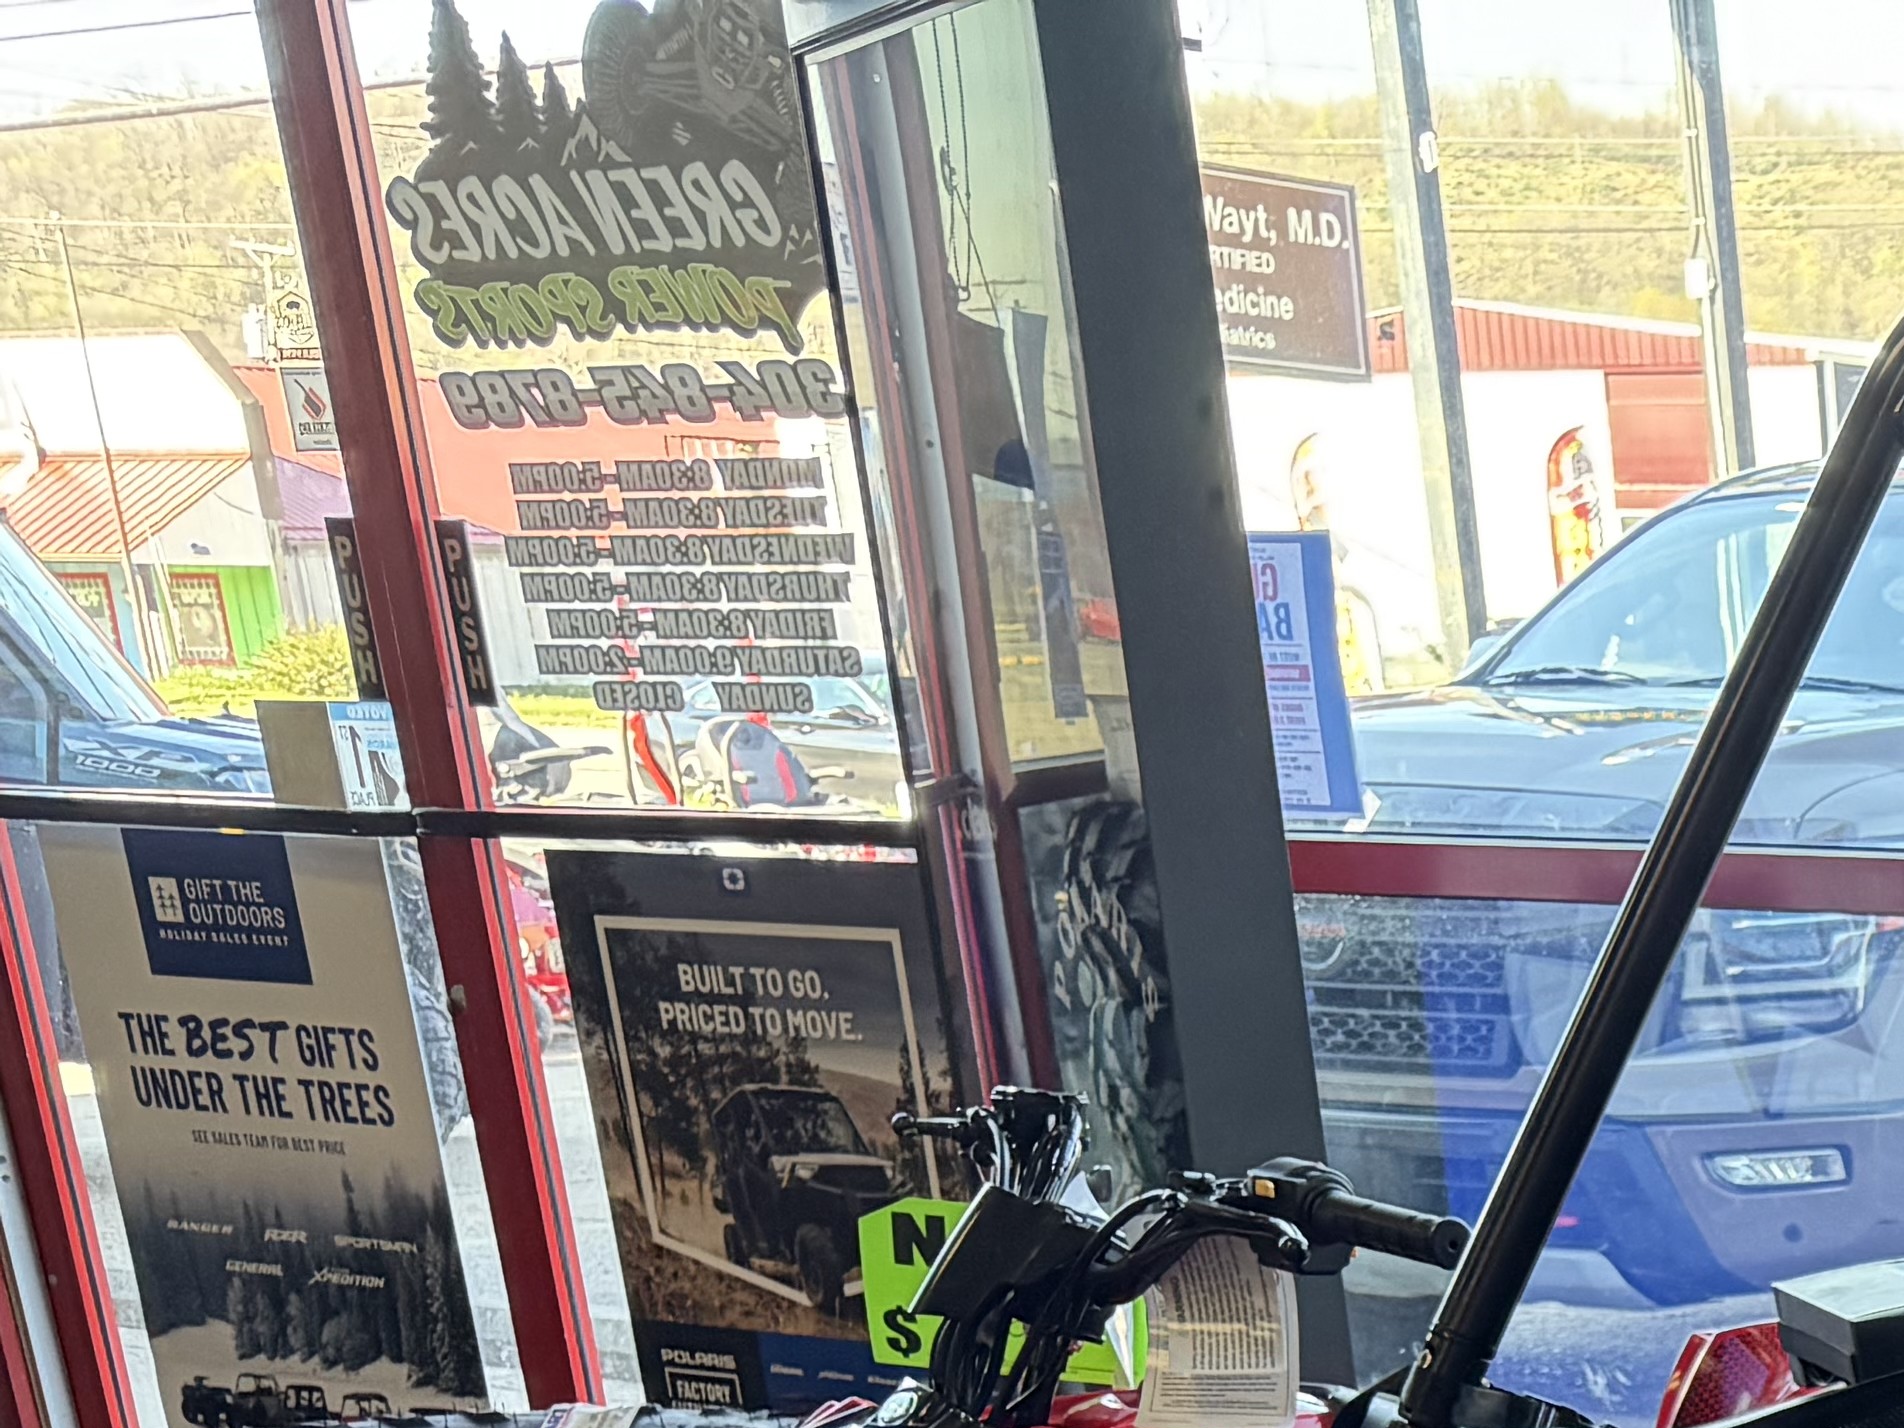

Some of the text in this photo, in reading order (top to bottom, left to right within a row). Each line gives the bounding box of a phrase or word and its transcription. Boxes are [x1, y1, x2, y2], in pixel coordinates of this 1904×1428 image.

[1286, 207, 1350, 249] M.D.
[1210, 245, 1276, 274] RTIFIED
[1216, 284, 1294, 321] edicine
[1220, 323, 1277, 350] iatrics
[333, 536, 378, 685] PUSH
[444, 538, 487, 690] PUSH
[75, 754, 161, 777] 1000
[184, 877, 264, 903] GIFT THE
[189, 903, 286, 929] OUTDOORS
[159, 929, 207, 942] HOLIDAY
[252, 934, 289, 947] EVENT
[677, 963, 744, 995] BUILT
[750, 966, 783, 997] TO
[658, 1001, 863, 1041] PRICED TO MOVE.
[118, 1012, 378, 1072] THE BEST GIFTS
[130, 1065, 395, 1127] UNDER THE TREES
[192, 1129, 209, 1144] SEE
[243, 1133, 270, 1149] TEAM
[271, 1135, 289, 1150] FOR
[291, 1137, 316, 1152] BEST
[318, 1139, 346, 1156] PRICE
[167, 1218, 234, 1236] RANGER
[225, 1259, 385, 1289] GENERAL XPEDITION
[661, 1348, 737, 1370] POLARIS
[676, 1381, 731, 1404] FACTORY
